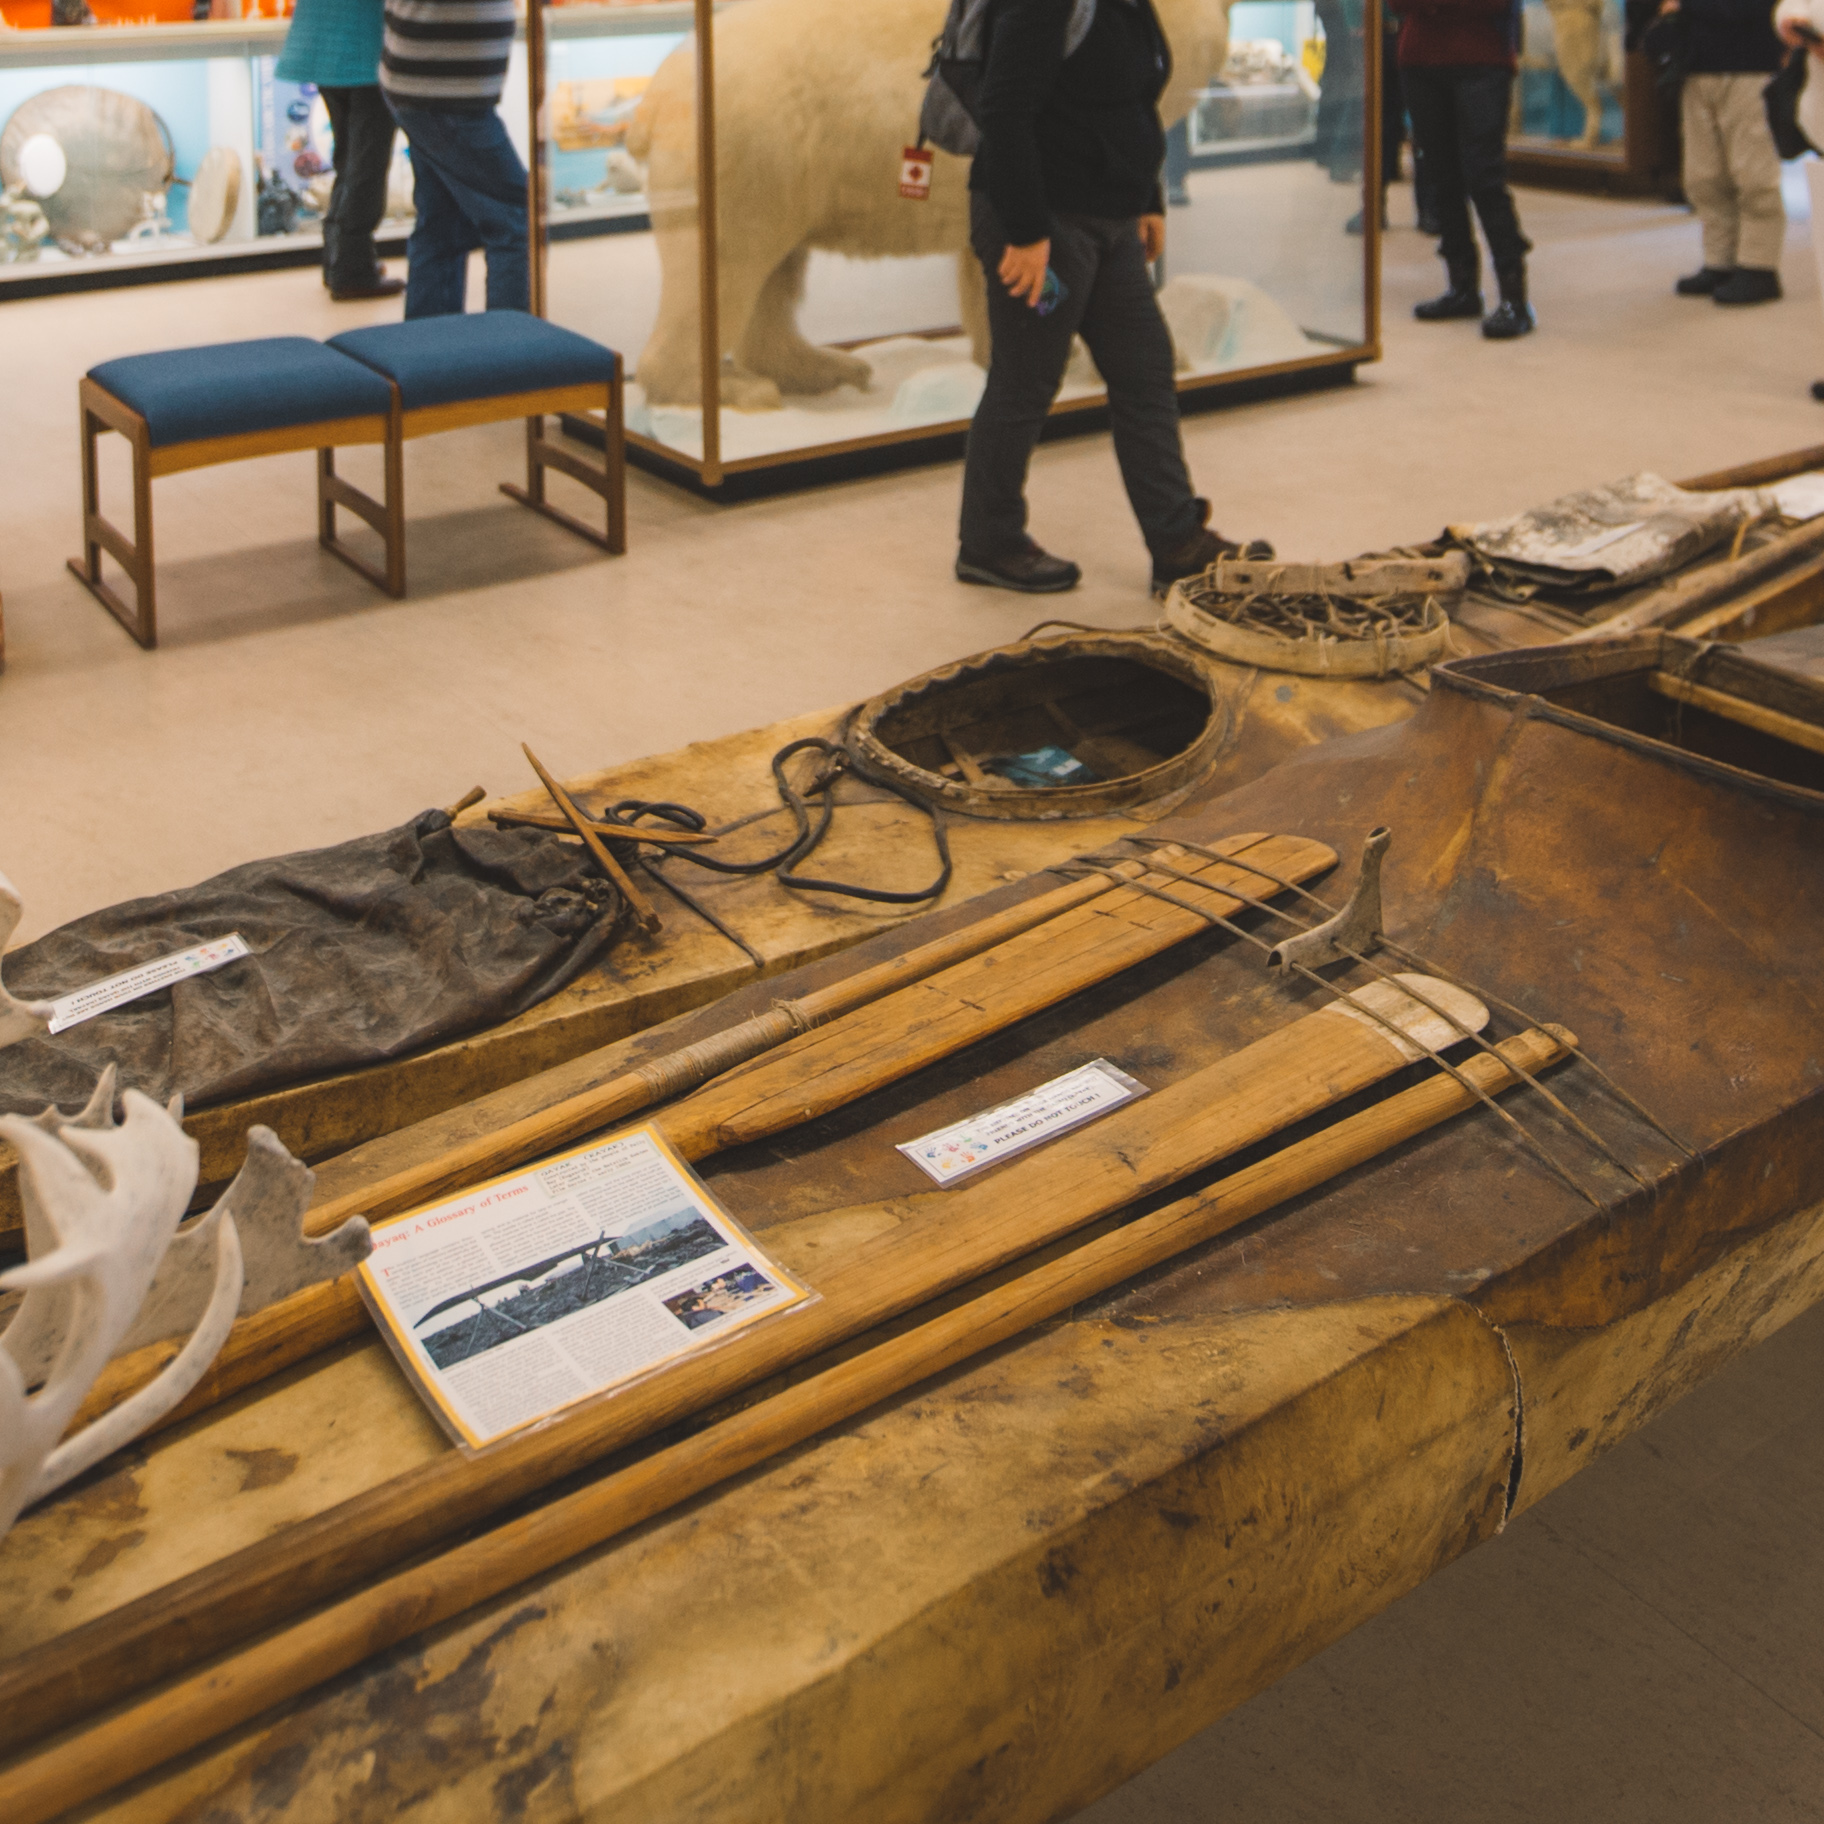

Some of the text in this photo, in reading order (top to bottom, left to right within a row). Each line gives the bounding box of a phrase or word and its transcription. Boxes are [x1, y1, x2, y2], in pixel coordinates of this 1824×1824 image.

[993, 1125, 1029, 1144] PLEASE
[1027, 1118, 1045, 1128] DO
[1042, 1109, 1064, 1121] NOT
[1063, 1095, 1095, 1111] TOUCH
[427, 1204, 476, 1228] Glossary
[479, 1197, 492, 1209] of
[494, 1184, 529, 1203] Terms
